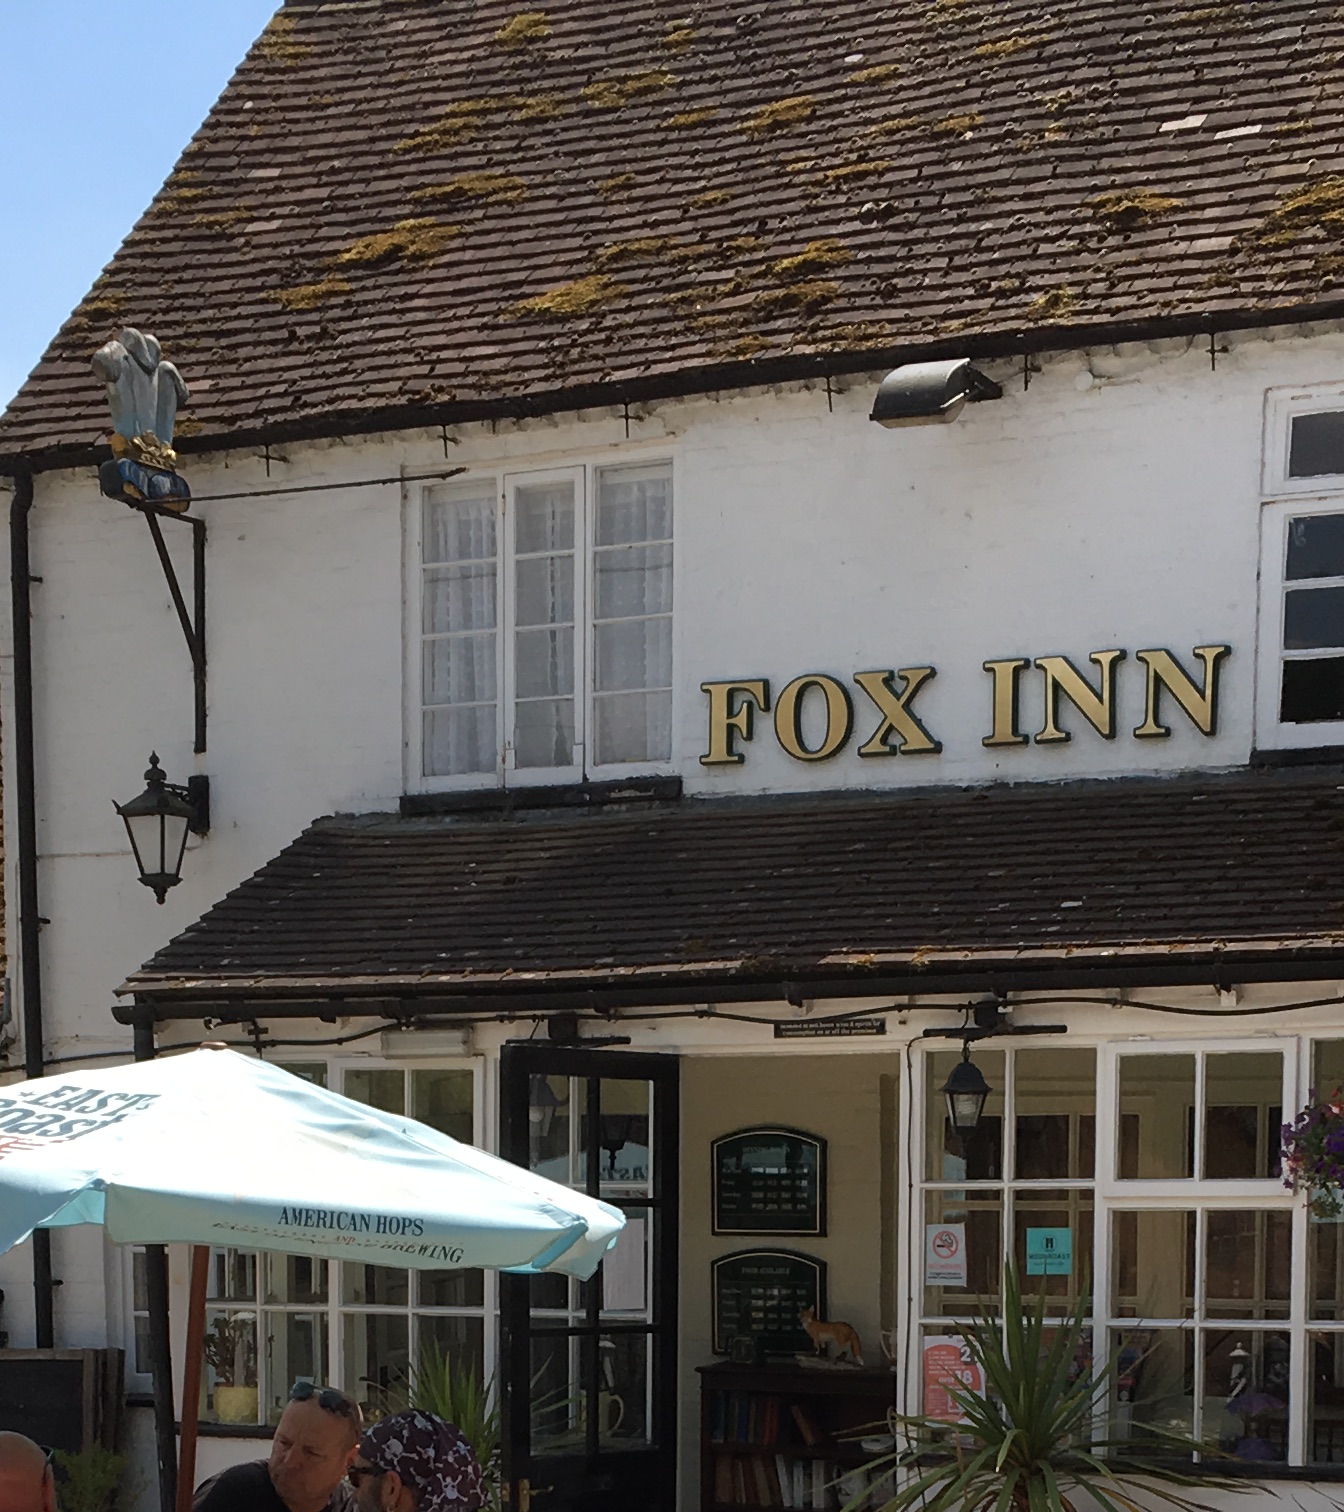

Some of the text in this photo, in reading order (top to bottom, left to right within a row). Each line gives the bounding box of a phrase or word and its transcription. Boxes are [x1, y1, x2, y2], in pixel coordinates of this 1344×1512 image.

[699, 645, 1231, 766] FOX INN
[23, 1086, 161, 1116] EAST
[278, 1206, 371, 1232] AMERICAN
[376, 1214, 424, 1236] HOPS
